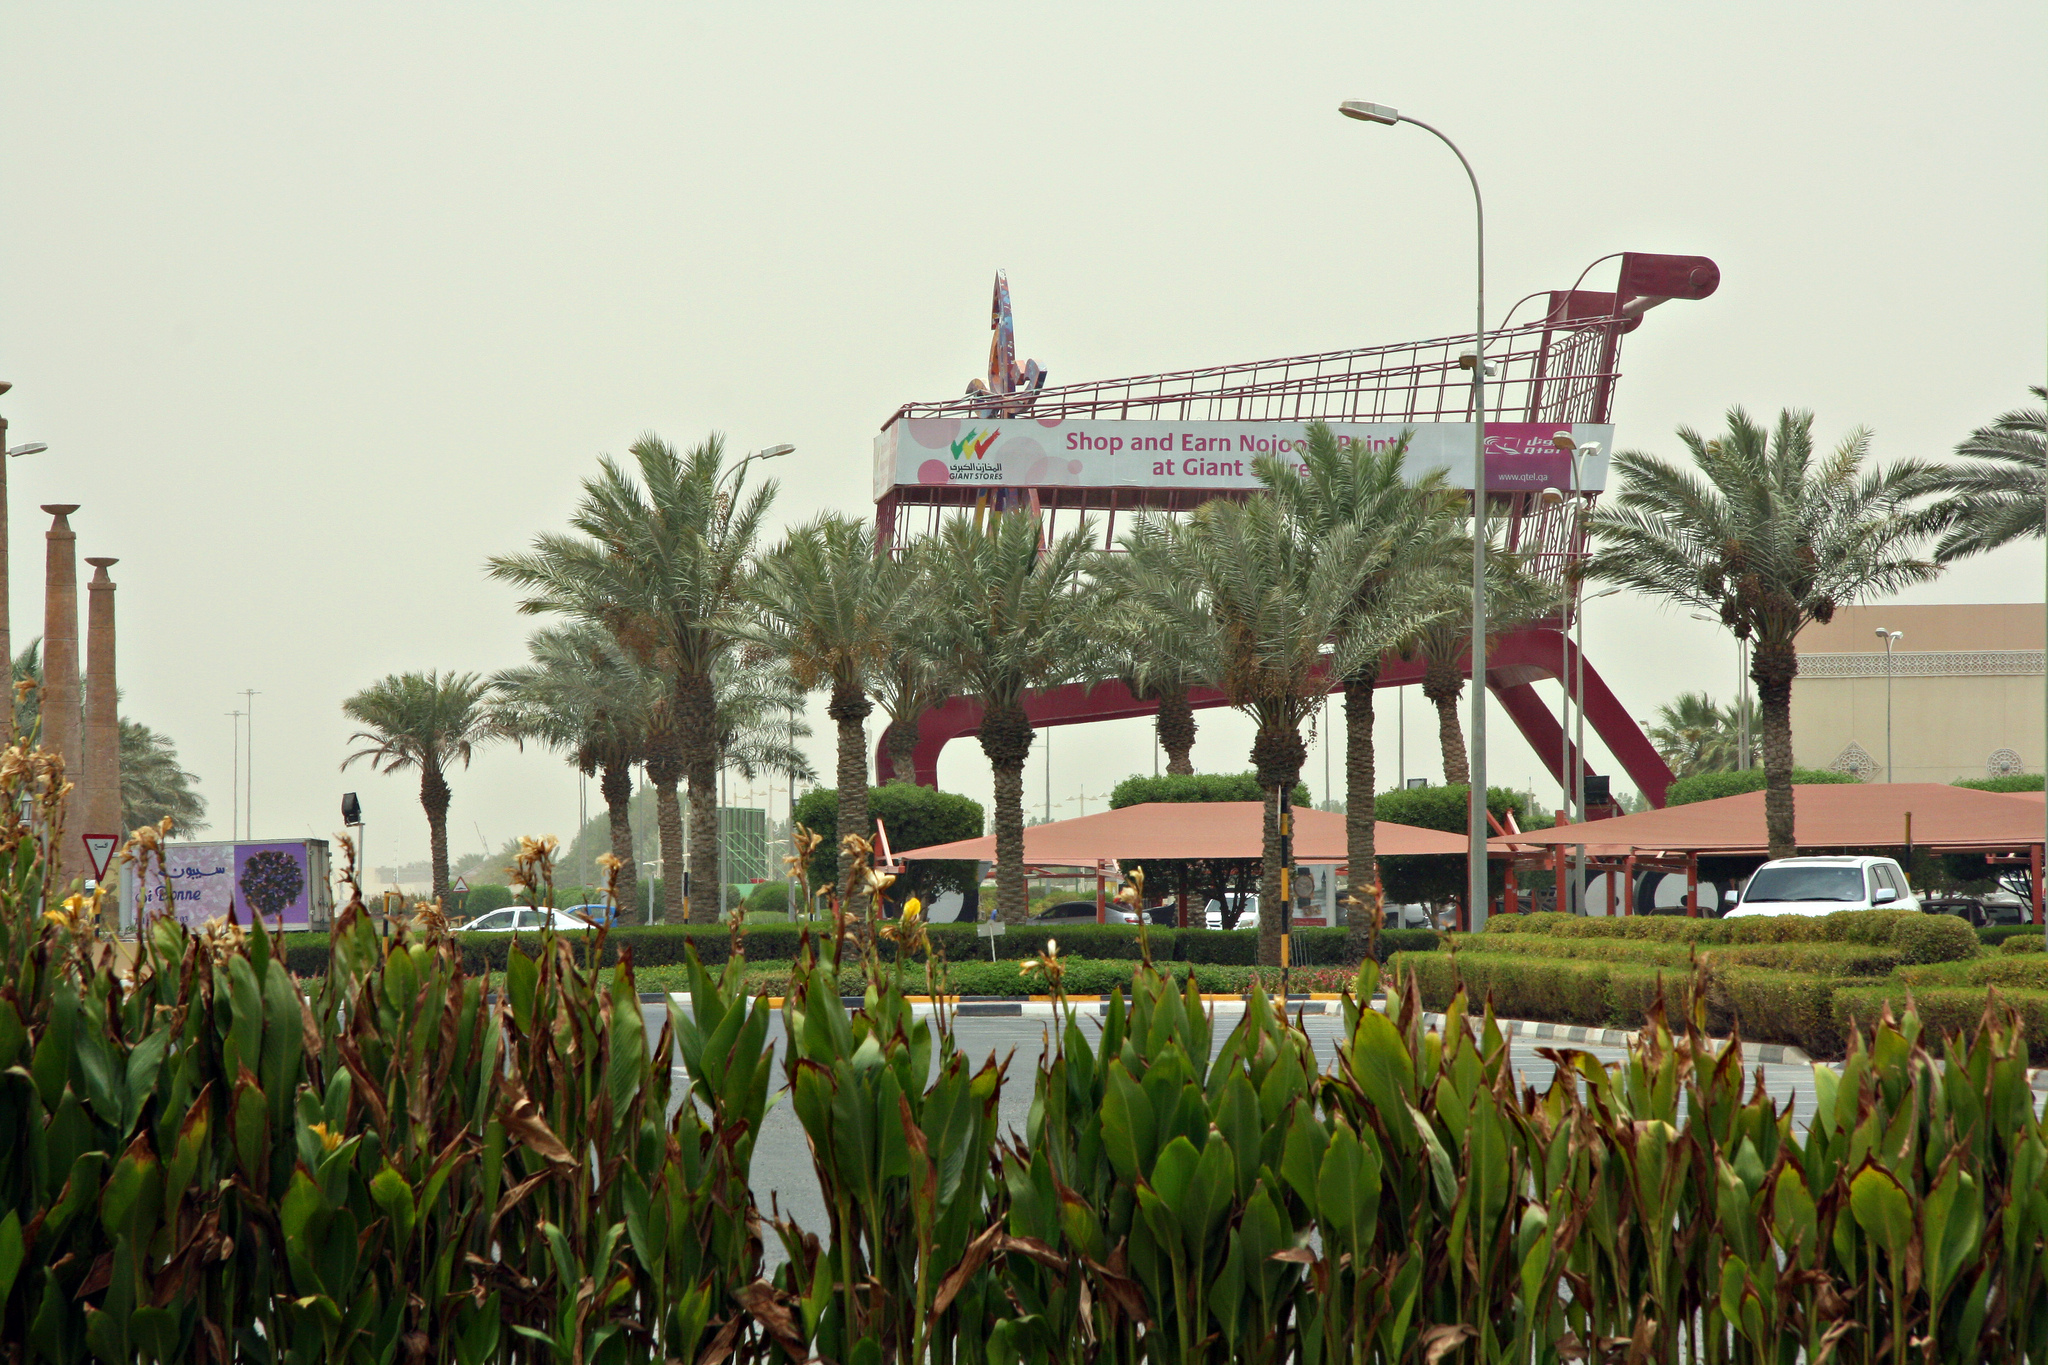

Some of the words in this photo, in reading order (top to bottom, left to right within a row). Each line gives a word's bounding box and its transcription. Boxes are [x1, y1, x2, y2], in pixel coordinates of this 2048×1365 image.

[1066, 431, 1123, 455] Shop
[1130, 433, 1173, 451] and
[1182, 434, 1231, 451] Earn
[975, 463, 1002, 473] المخازن
[1153, 459, 1175, 476] at
[1183, 458, 1243, 476] Giant
[1498, 473, 1548, 482] www.qtel.qa
